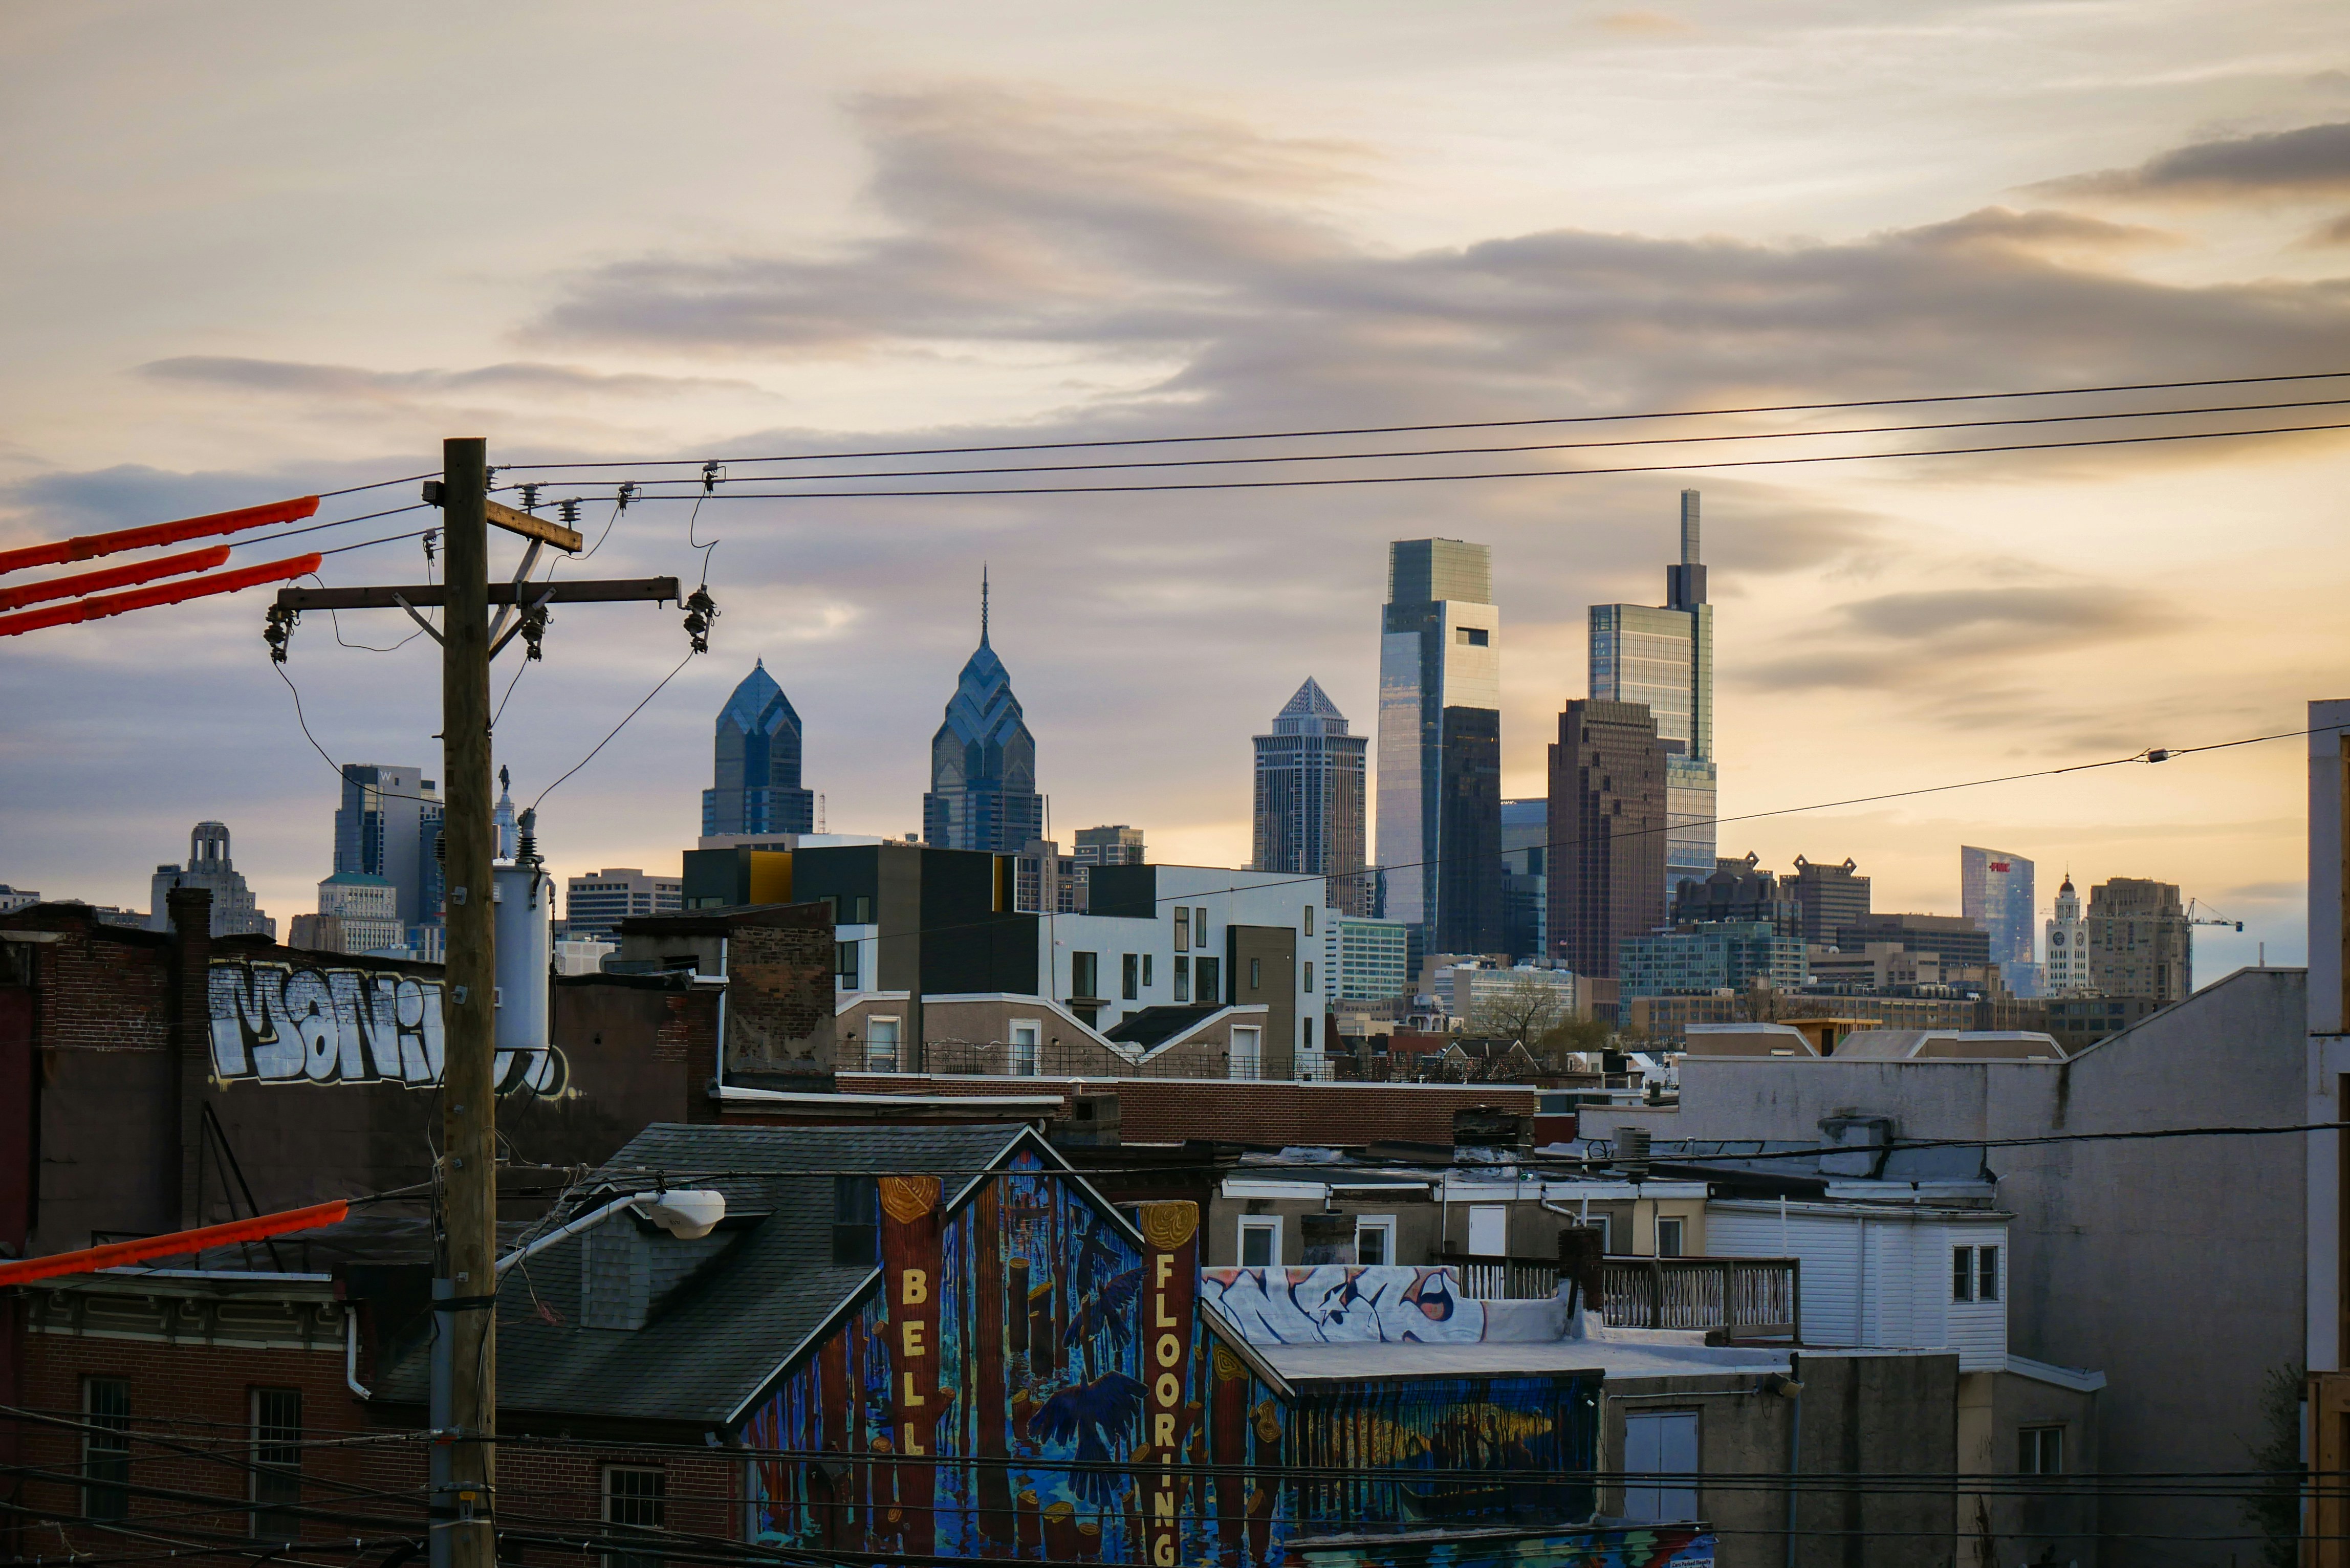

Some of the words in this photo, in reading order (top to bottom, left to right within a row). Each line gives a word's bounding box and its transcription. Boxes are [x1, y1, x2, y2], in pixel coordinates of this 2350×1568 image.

[380, 771, 391, 781] W
[1991, 862, 2010, 873] FMC
[902, 1269, 927, 1455] BELL
[1154, 1254, 1180, 1567] FLOORING
